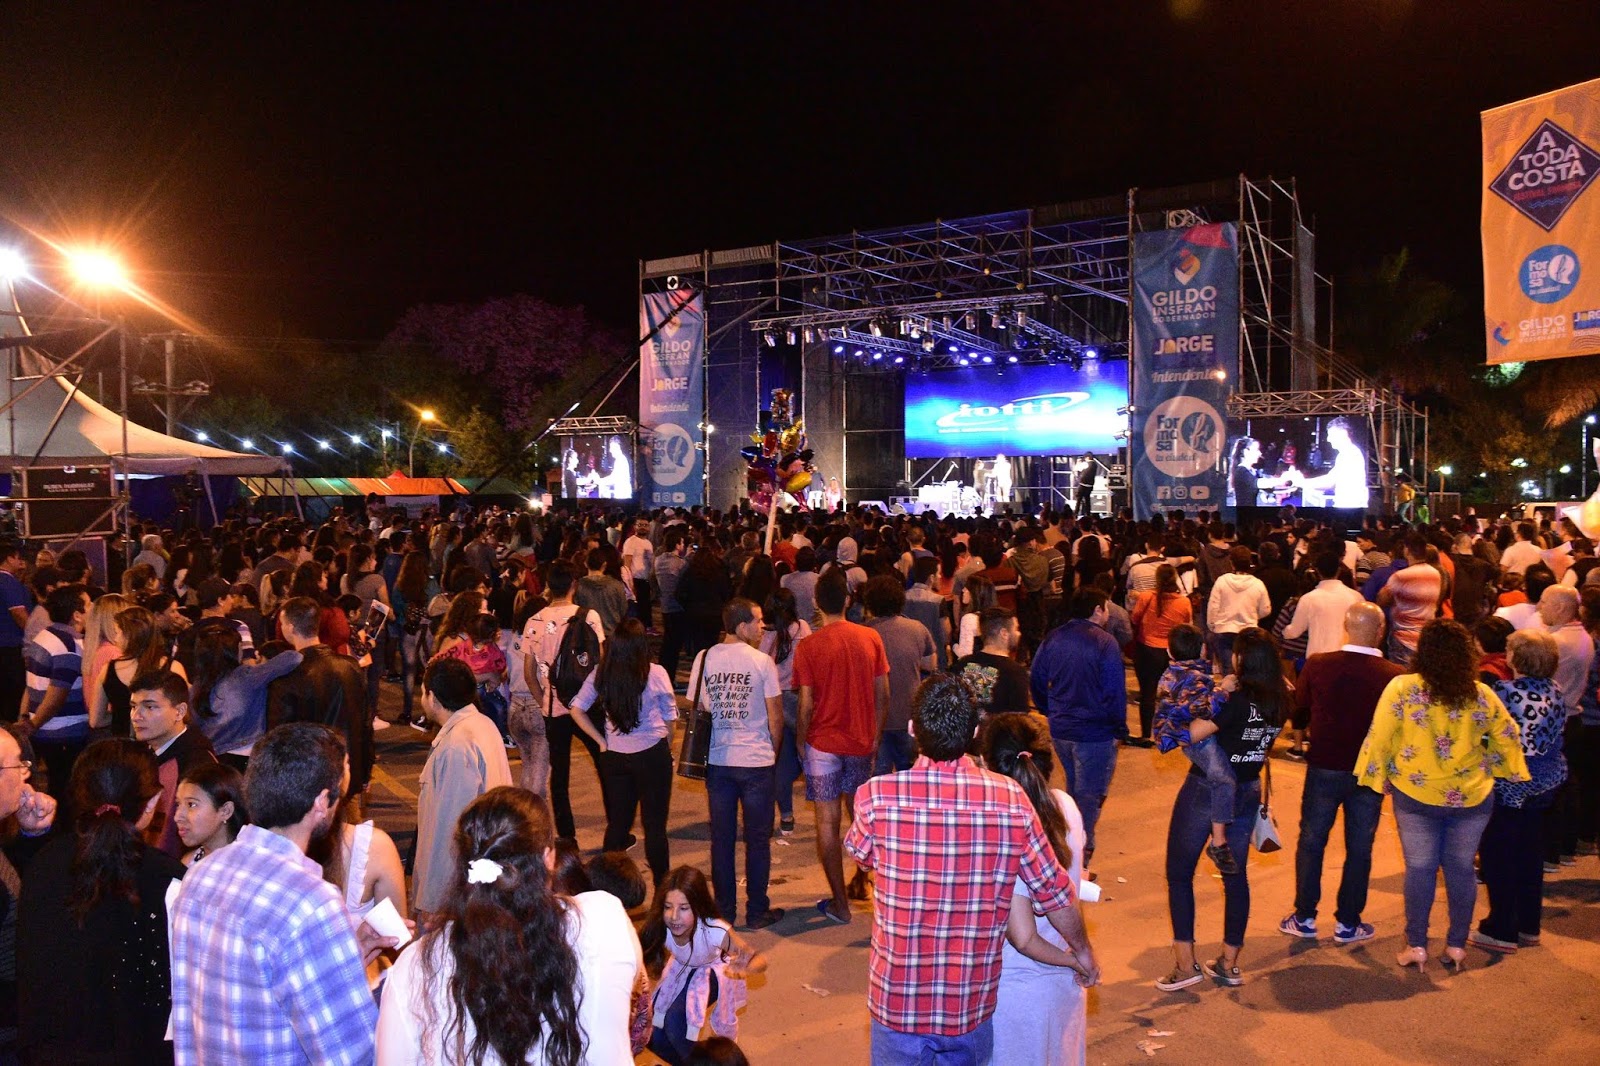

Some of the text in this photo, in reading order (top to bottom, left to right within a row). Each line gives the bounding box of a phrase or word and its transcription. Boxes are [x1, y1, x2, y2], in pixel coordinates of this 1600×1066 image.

[1536, 131, 1556, 151] A
[1519, 144, 1580, 170] TODA
[1508, 160, 1587, 190] COSTA
[1152, 285, 1217, 306] GILDO
[1152, 301, 1216, 316] INSFRAN
[1152, 312, 1216, 324] GOBERNADOR
[1519, 315, 1566, 331] GILDO
[653, 340, 691, 354] GILDO
[1153, 334, 1214, 355] JORGE
[1152, 369, 1217, 383] Intendente
[651, 377, 689, 391] JORGE
[1157, 414, 1180, 429] For
[704, 672, 751, 687] VOLVERÉ
[725, 692, 750, 701] AMOR
[713, 701, 736, 710] PORQUE
[720, 710, 749, 720] SIENTO
